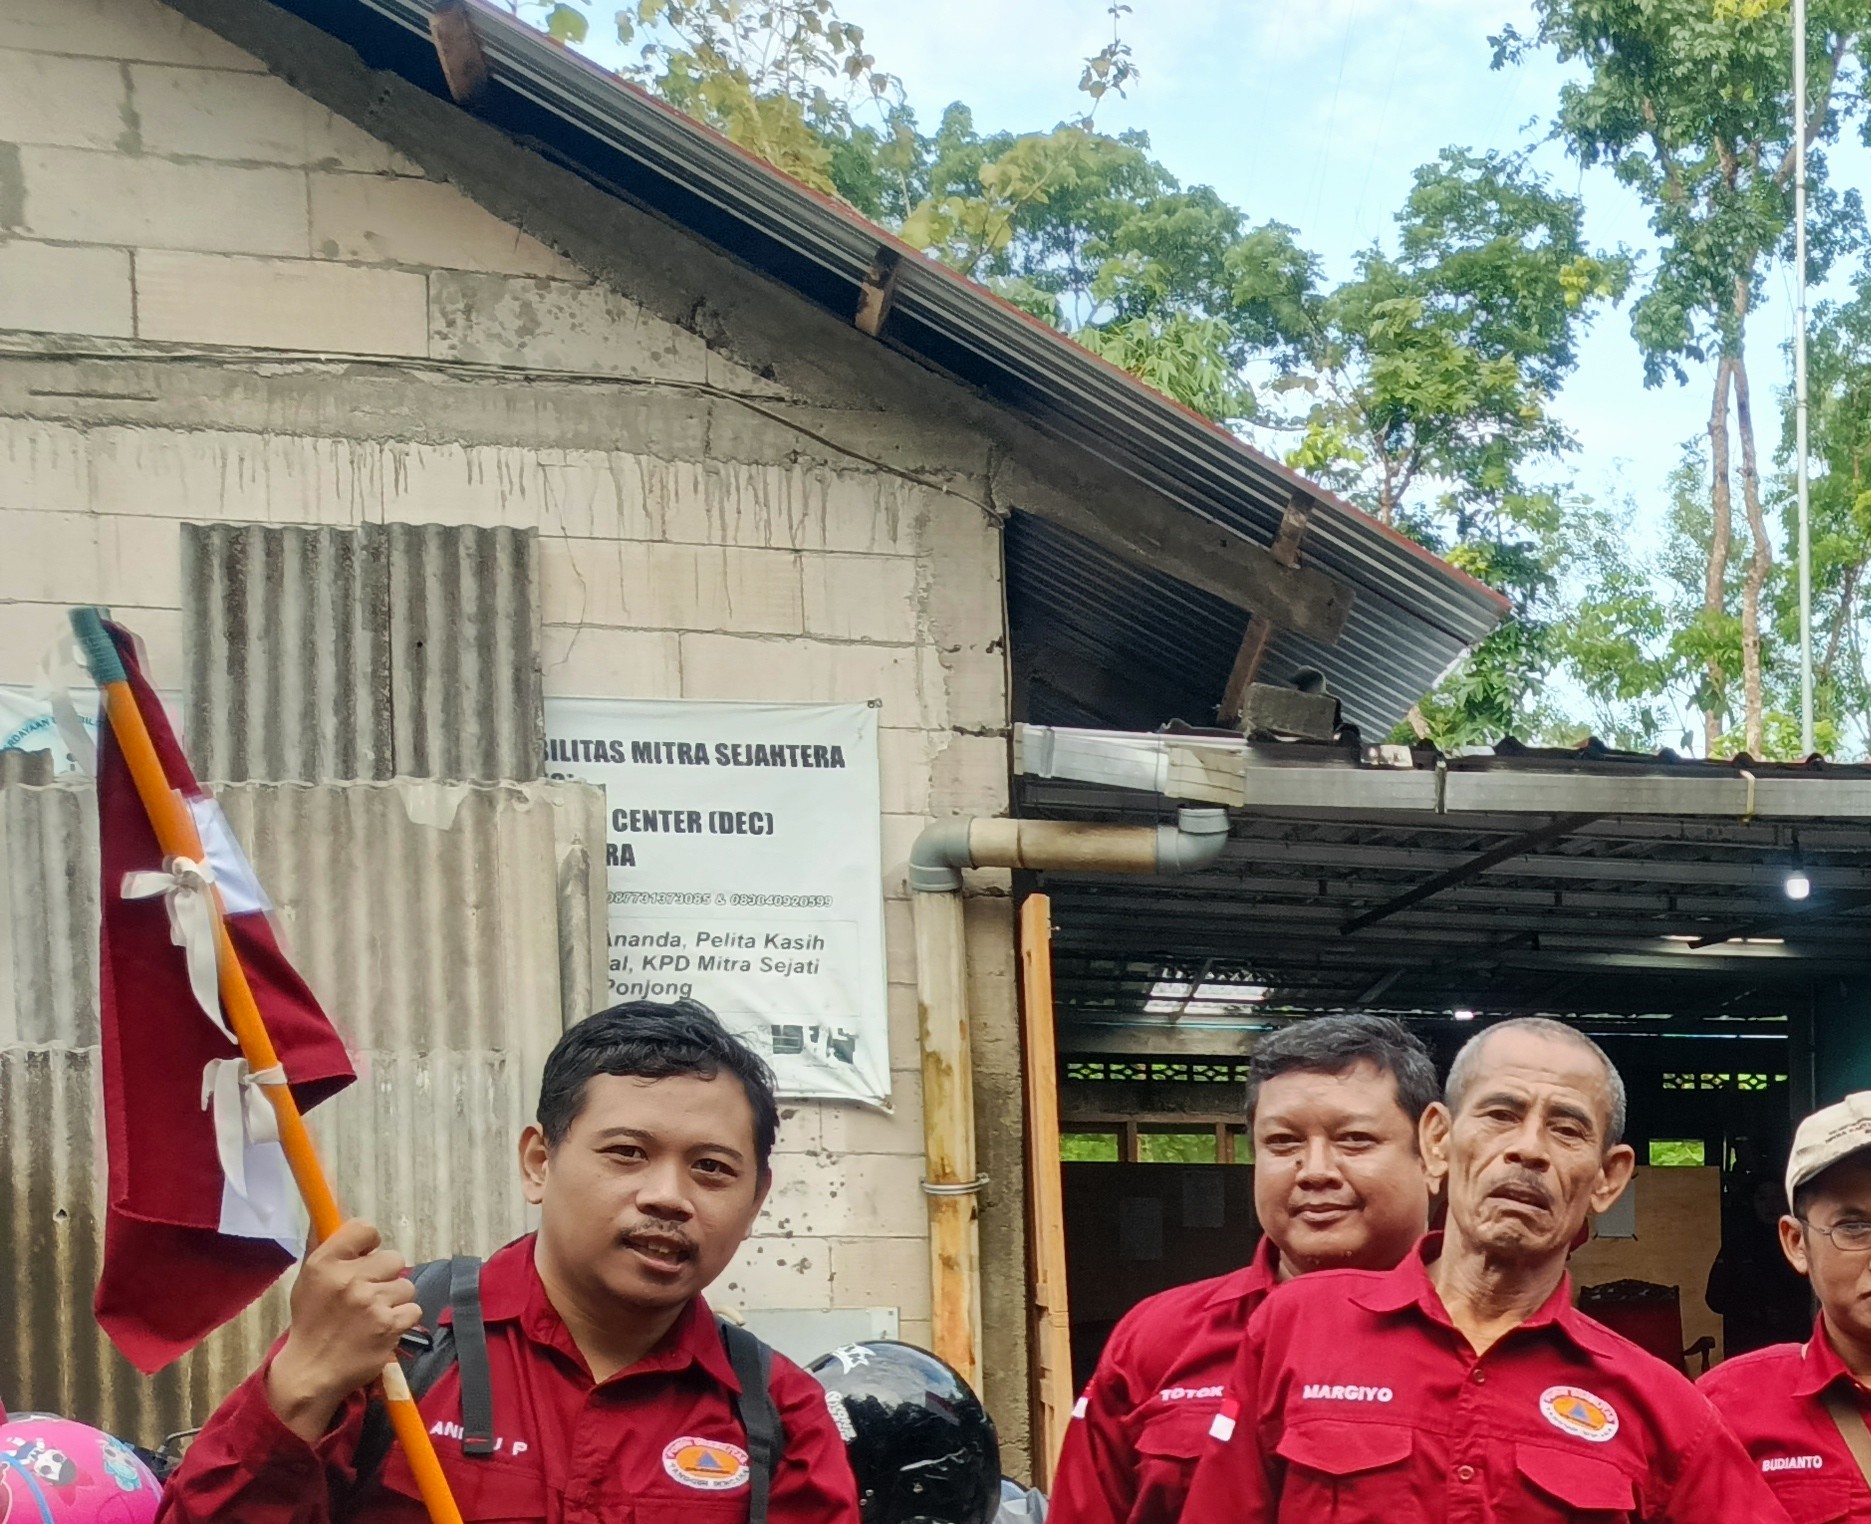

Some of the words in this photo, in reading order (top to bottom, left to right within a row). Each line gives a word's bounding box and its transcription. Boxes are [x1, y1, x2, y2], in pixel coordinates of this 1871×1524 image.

[631, 741, 709, 766] MITRA
[715, 742, 846, 768] SEJAHTERA
[612, 808, 702, 834] CENTER
[716, 893, 726, 906] &
[695, 932, 756, 948] Pelita
[764, 933, 825, 951] Kasih
[642, 955, 690, 972] KPD
[697, 956, 751, 972] Mitra
[760, 957, 820, 977] Sejati
[1159, 1385, 1225, 1402] TOTOK
[1303, 1384, 1393, 1402] MARGIYO
[1762, 1455, 1822, 1472] BUDIANTO
